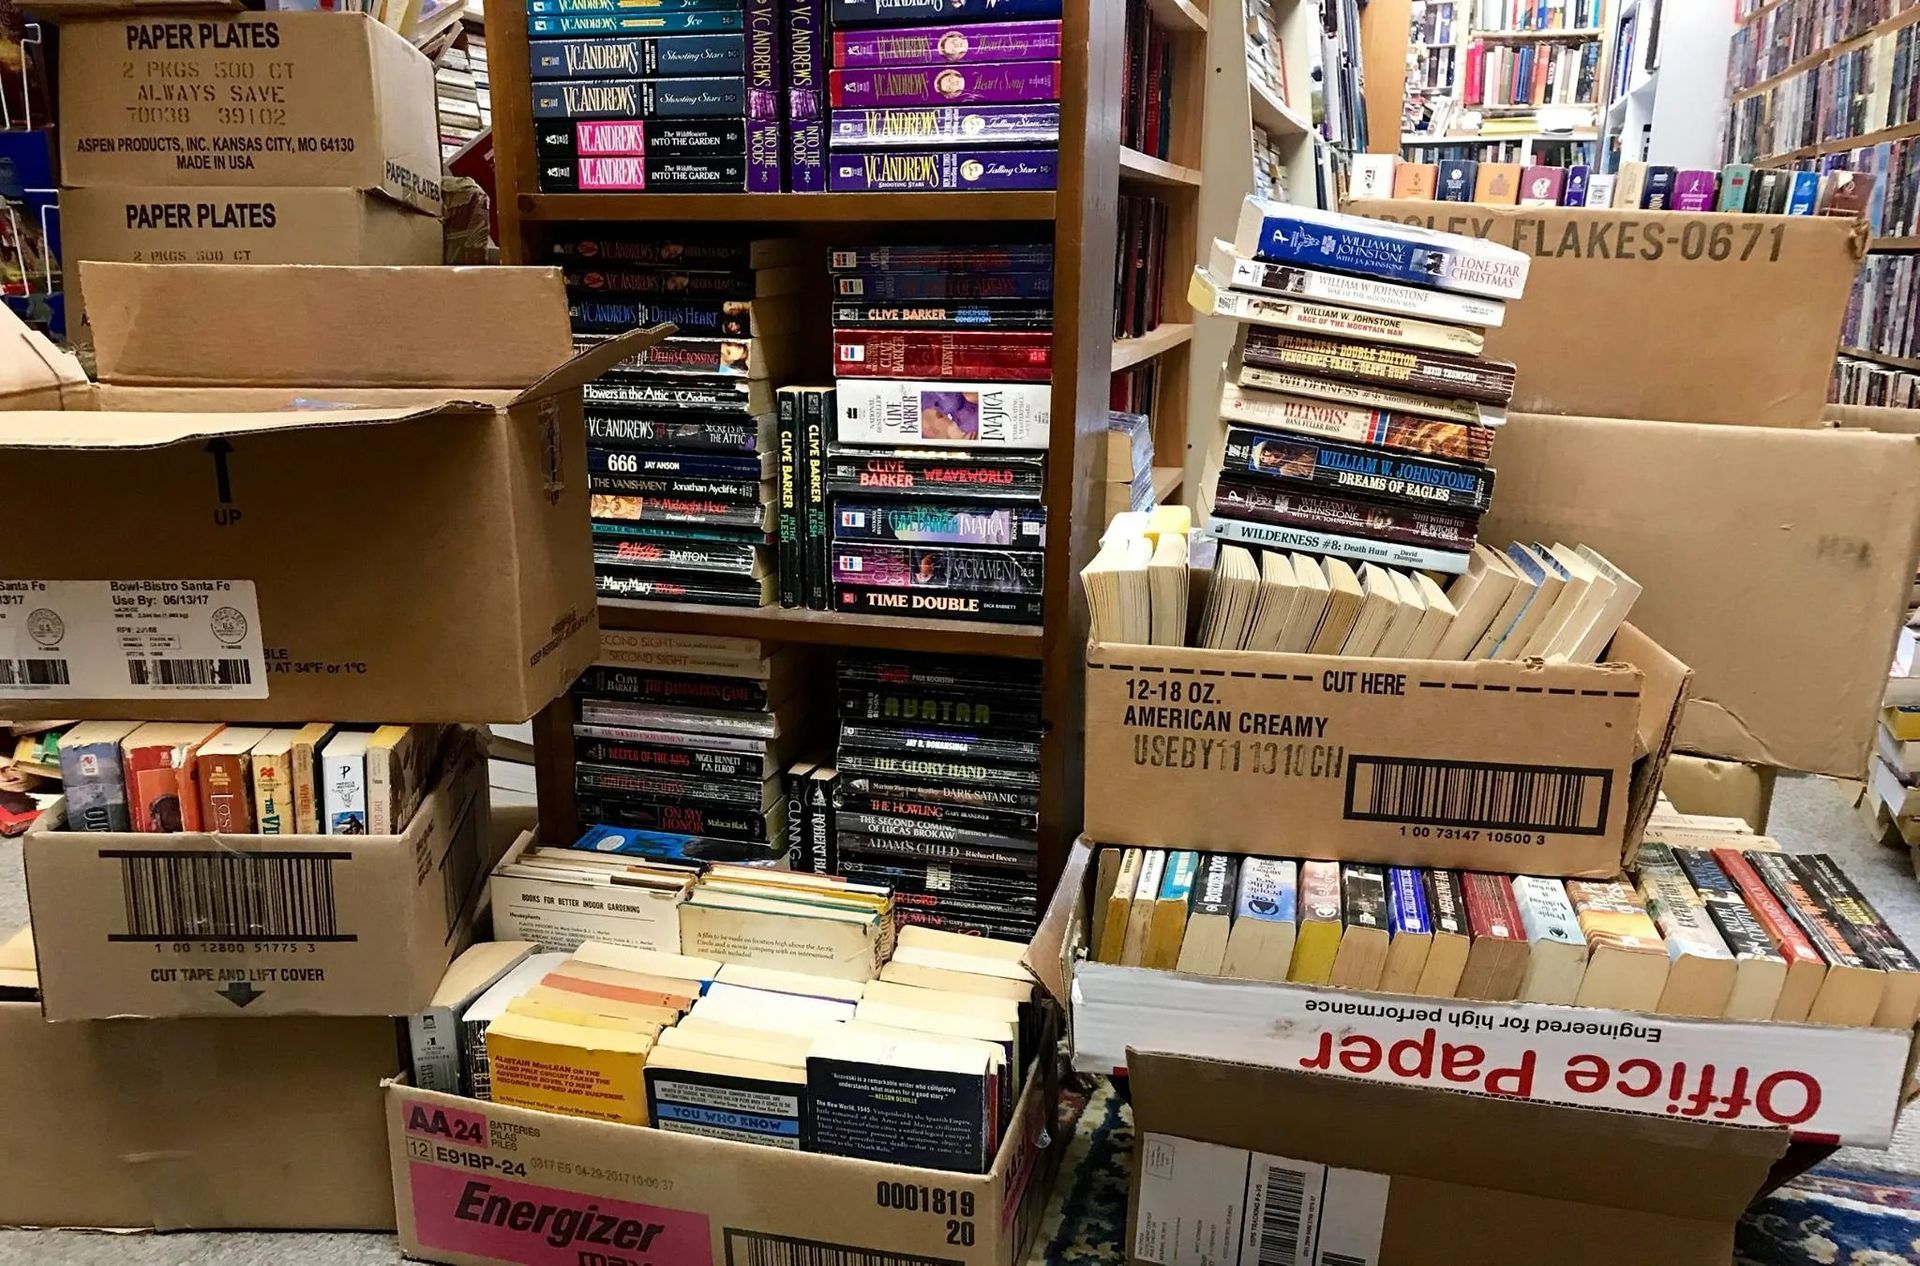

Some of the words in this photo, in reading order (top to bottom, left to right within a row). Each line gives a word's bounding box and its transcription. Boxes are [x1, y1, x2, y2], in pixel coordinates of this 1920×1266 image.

[126, 24, 195, 51] PAPER
[199, 22, 280, 49] PLATES
[662, 49, 699, 61] Shooting
[701, 49, 725, 59] Stars
[752, 29, 774, 87] ANDREWS
[791, 28, 814, 86] ANDREWS
[123, 62, 134, 78] 2
[147, 62, 200, 79] PKGS
[215, 62, 255, 79] 500
[270, 63, 295, 79] CT
[138, 84, 216, 102] ALWAYS
[231, 85, 285, 102] SAVE
[660, 92, 698, 104] Shooting
[699, 91, 721, 102] Stars
[77, 137, 115, 152] ASPEN
[117, 137, 184, 153] PRODUCTS,
[186, 137, 210, 152] INC.
[213, 137, 262, 152] KANSAS
[264, 137, 295, 154] CITY,
[298, 138, 318, 152] MO
[320, 138, 354, 152] 64130
[651, 137, 671, 146] INTO
[672, 137, 686, 145] THE
[688, 137, 720, 145] GARDEN
[764, 126, 777, 148] INTO
[806, 126, 818, 148] INTO
[752, 130, 765, 165] WOODS
[793, 130, 807, 165] WOODS
[176, 155, 209, 170] MADE
[213, 155, 226, 169] IN
[228, 155, 254, 170] USA
[765, 148, 777, 168] THE
[807, 148, 820, 168] THE
[651, 172, 671, 180] INTO
[672, 172, 686, 180] THE
[688, 172, 720, 180] GARDEN
[1014, 163, 1038, 174] Stars
[385, 159, 412, 191] PAPER
[410, 171, 440, 201] PLATES
[126, 203, 191, 229] PAPER
[197, 203, 276, 228] PLATES
[1512, 218, 1786, 262] FLAKES-0671
[133, 251, 142, 261] 2
[150, 251, 186, 261] PKGS
[196, 251, 222, 261] 500
[234, 251, 252, 261] CT
[1336, 243, 1405, 264] JOHNSTONE
[1450, 257, 1458, 267] A
[1460, 258, 1488, 271] LONE
[1493, 264, 1519, 277] STAR
[1451, 268, 1513, 288] CHRISTMAS
[868, 309, 899, 320] CLIVE
[903, 309, 946, 320] BARKER
[1303, 308, 1338, 319] WILLIAM
[1340, 312, 1350, 320] W.
[1352, 313, 1401, 328] JOHNSTONE
[583, 384, 618, 401] Flowers
[628, 387, 643, 400] the
[644, 386, 668, 401] Attic
[781, 431, 792, 463] CLIVE
[808, 424, 819, 457] CLIVE
[608, 454, 637, 472] 666
[644, 461, 657, 469] JAY
[657, 461, 680, 470] ANSON
[867, 460, 905, 473] CLIVE
[1320, 451, 1377, 473] WILLIAM
[1380, 459, 1393, 475] W.
[1397, 460, 1476, 490] JOHNSTONE
[809, 459, 821, 502] BARKER
[860, 473, 913, 487] BARKER
[923, 467, 1014, 484] WEAVEWORLD
[593, 478, 611, 488] THE
[613, 479, 667, 491] VANISHMENT
[672, 482, 707, 493] Jonathan
[708, 484, 738, 495] Aycliffe
[782, 466, 793, 509] BARKER
[1338, 472, 1386, 490] DREAMS
[1388, 480, 1405, 493] OF
[1406, 483, 1450, 501] EAGLES
[214, 509, 242, 525] UP
[1240, 527, 1319, 547] WILDERNESS
[1322, 540, 1342, 551] #8:
[1344, 543, 1367, 554] Death
[1369, 546, 1388, 557] Hunt
[670, 551, 709, 562] BARTON
[110, 582, 179, 591] Bowl-Bistro
[181, 582, 214, 591] Santa
[217, 582, 230, 591] Fe
[113, 596, 135, 605] Use
[137, 596, 157, 607] By:
[163, 595, 208, 606] 06/13/17
[866, 593, 908, 607] TIME
[912, 595, 979, 612] DOUBLE
[609, 651, 653, 663] SECOND
[656, 654, 688, 666] SIGHT
[607, 681, 638, 693] BARKER
[1126, 679, 1181, 702] 12-18
[1188, 682, 1222, 705] OZ.
[1322, 670, 1358, 693] CUT
[1360, 673, 1406, 696] HERE
[1124, 705, 1231, 732] AMERICAN
[1238, 712, 1328, 738] CREAMY
[874, 758, 898, 769] THE
[902, 760, 945, 774] GLORY
[950, 764, 986, 778] HAND
[811, 813, 826, 855] ROBERT
[882, 826, 911, 836] LUCAS
[914, 829, 956, 840] BROKAW
[1400, 826, 1406, 836] 1
[1413, 827, 1430, 837] 00
[1437, 828, 1480, 841] 73147
[1487, 832, 1531, 844] 10500
[1537, 835, 1545, 845] 3
[522, 894, 540, 903] BOOKS
[544, 896, 554, 904] FOR
[558, 897, 579, 907] BETTER
[583, 901, 604, 909] INDOOR
[608, 903, 640, 913] GARDENING
[155, 943, 161, 952] 1
[173, 943, 191, 952] 00
[201, 943, 244, 952] 12800
[255, 943, 297, 953] 51775
[308, 943, 315, 953] 3
[150, 968, 177, 982] CUT
[180, 968, 214, 982] TAPE
[218, 968, 246, 982] AND
[249, 968, 277, 981] LIFT
[280, 968, 324, 982] COVER
[1305, 1000, 1442, 1022] performance
[1449, 1011, 1494, 1030] high
[1499, 1017, 1530, 1031] for
[1536, 1019, 1662, 1042] Engineered
[495, 1056, 530, 1067] ALISTAIR
[533, 1061, 571, 1073] MacLEAN
[1299, 1028, 1537, 1098] Paper
[1565, 1053, 1823, 1125] Office
[409, 1106, 452, 1138] AA
[454, 1122, 483, 1144] 24
[673, 1107, 700, 1118] YOU
[705, 1112, 736, 1123] WHO
[740, 1116, 781, 1130] KNOW
[490, 1120, 540, 1138] BATTERIES
[490, 1130, 518, 1142] PILAS
[491, 1139, 518, 1151] PILES
[409, 1142, 428, 1158] 12
[436, 1146, 527, 1178] E91BP-24
[877, 1181, 975, 1217] 0001819
[454, 1180, 664, 1252] Energizer
[947, 1220, 975, 1247] 20
